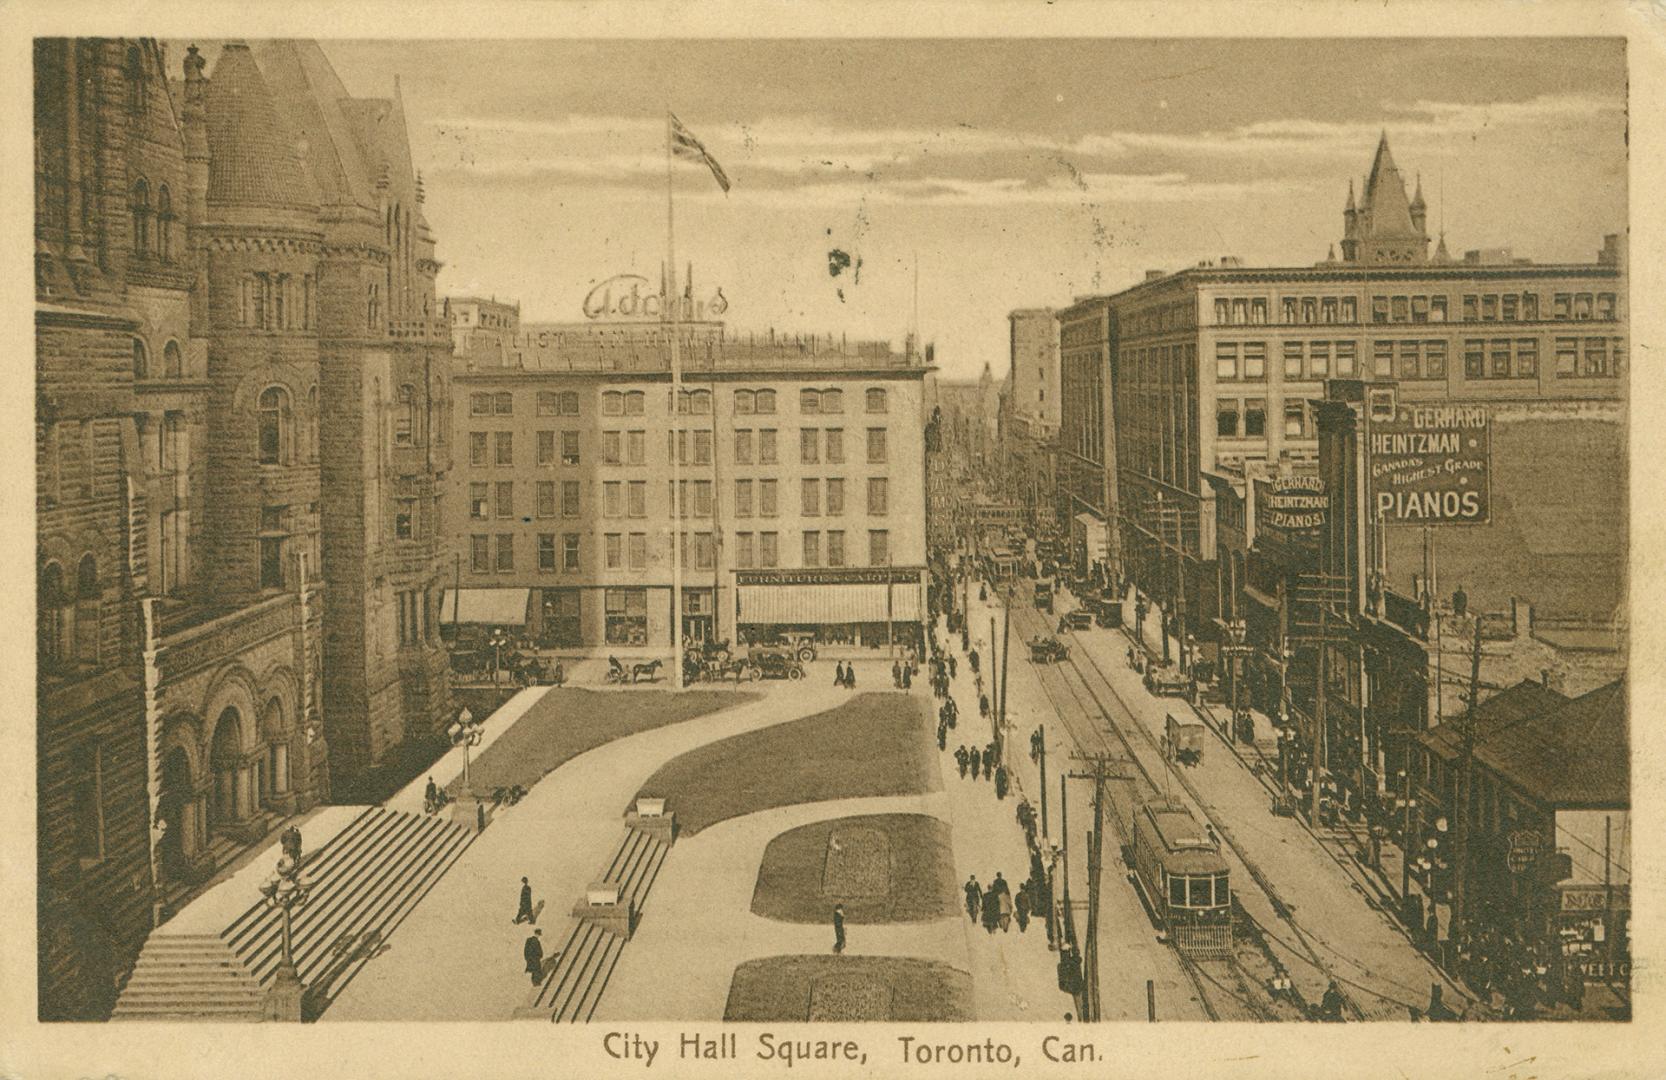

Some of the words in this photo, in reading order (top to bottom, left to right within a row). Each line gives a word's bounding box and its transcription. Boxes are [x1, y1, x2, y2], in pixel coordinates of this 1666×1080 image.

[1413, 407, 1485, 429] GERHARD
[1371, 433, 1460, 454] HEINTZMAN
[1274, 476, 1323, 492] GERHARD
[1270, 496, 1329, 508] HEINTZMAN
[1377, 491, 1479, 519] PIANOS
[1274, 512, 1321, 528] PIANOS
